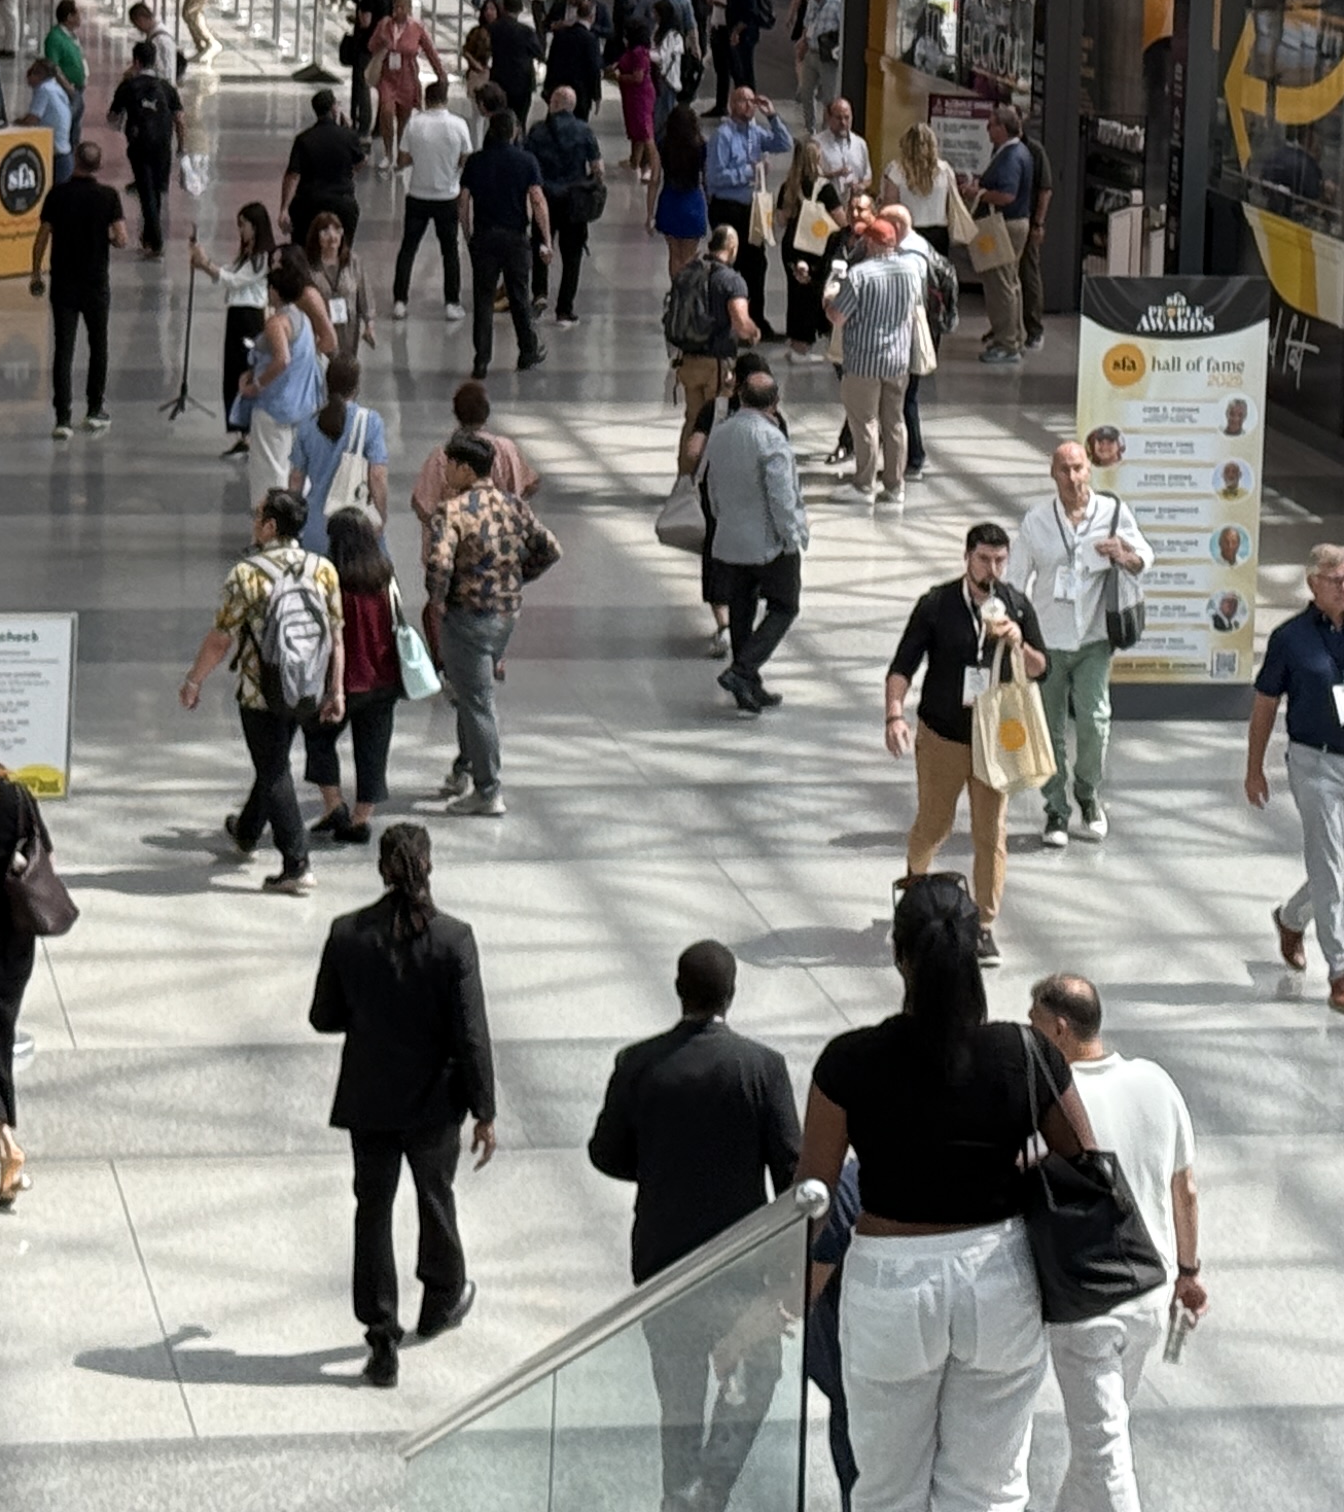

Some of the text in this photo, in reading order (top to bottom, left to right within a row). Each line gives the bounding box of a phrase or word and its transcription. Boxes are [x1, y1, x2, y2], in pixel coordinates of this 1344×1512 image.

[7, 163, 36, 192] sfa
[1136, 314, 1216, 333] AWARDS
[1111, 355, 1246, 374] sfa hall of fame
